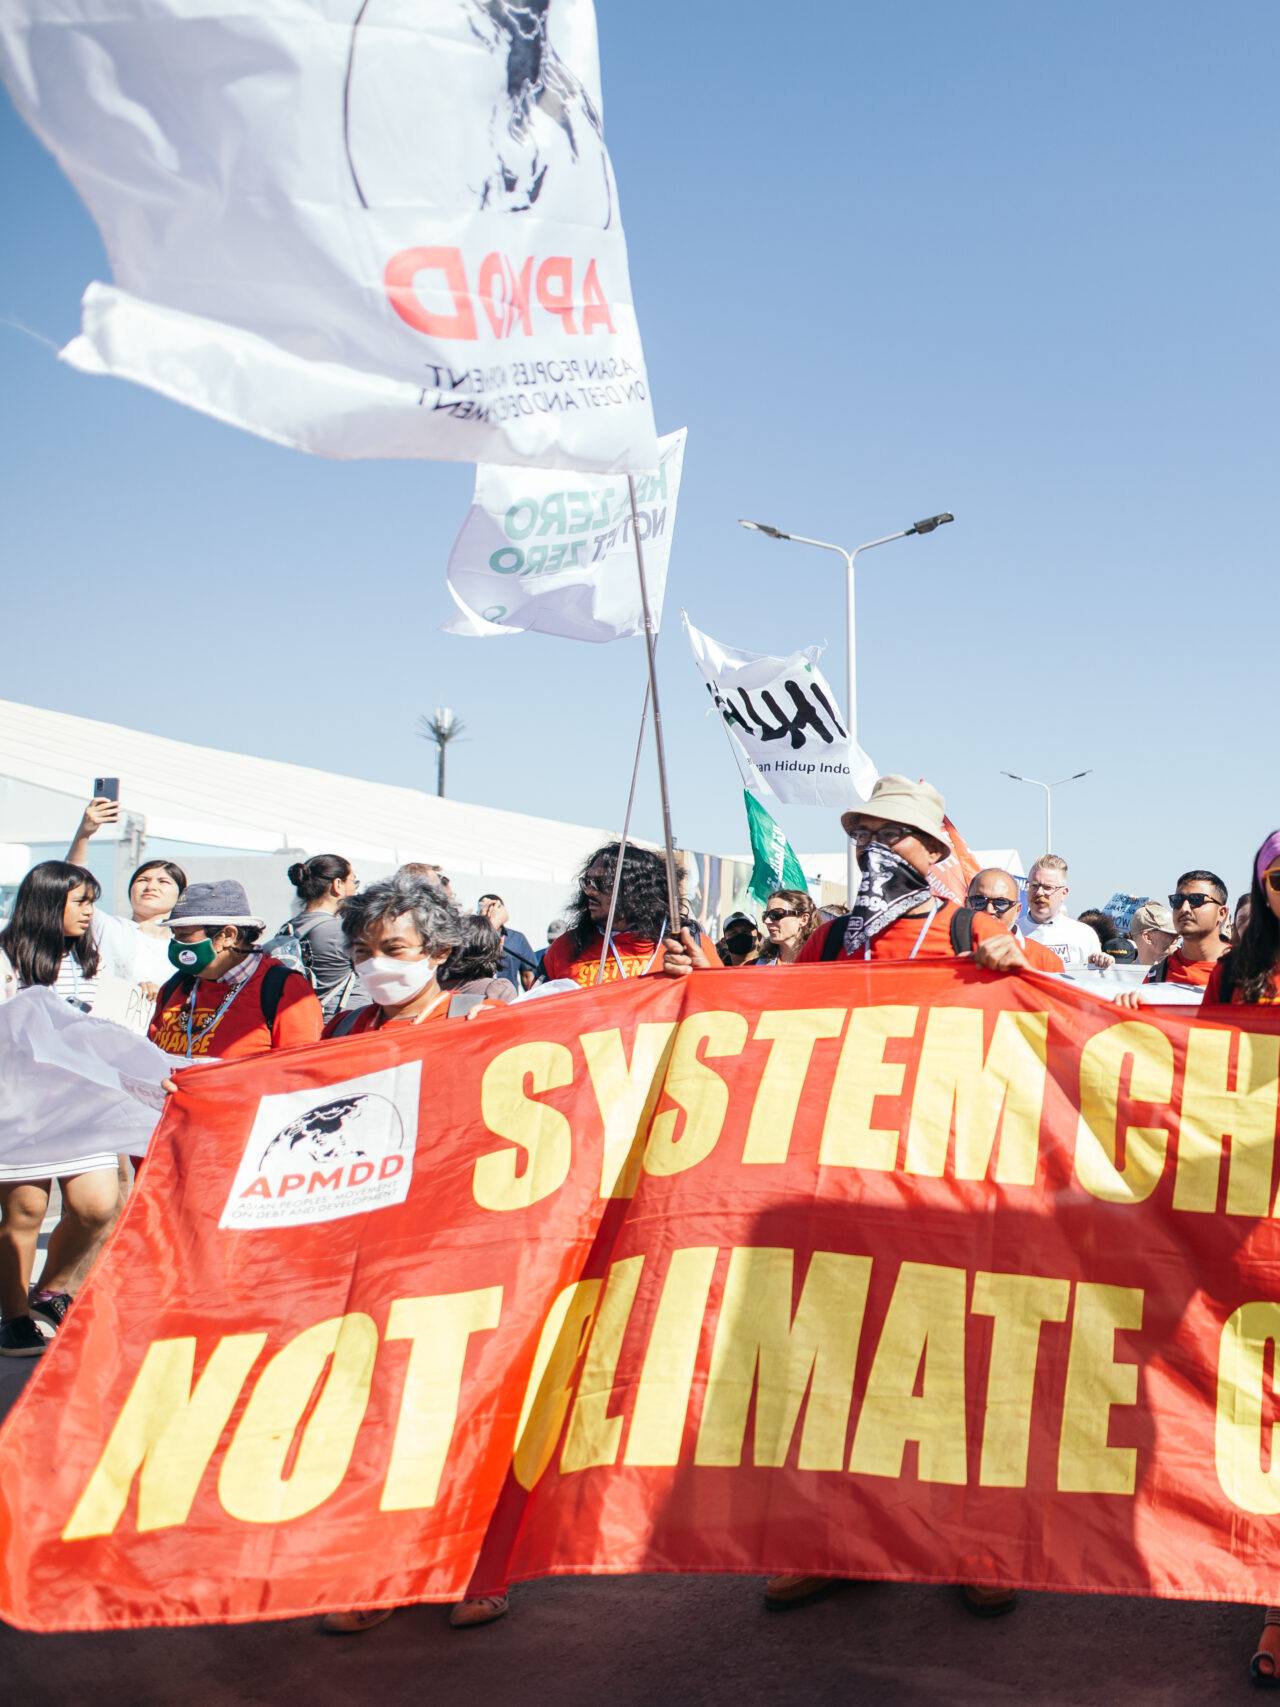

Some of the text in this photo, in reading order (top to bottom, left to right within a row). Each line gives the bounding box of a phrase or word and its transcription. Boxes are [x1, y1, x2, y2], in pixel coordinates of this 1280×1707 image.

[775, 760, 816, 775] Hidup
[820, 763, 851, 775] Indo
[126, 987, 153, 1031] PAY
[473, 1005, 1048, 1211] SYSTEM
[237, 1200, 277, 1210] ASIAN
[334, 1180, 399, 1199] MOVEMENT
[238, 1154, 405, 1199] APMDD
[231, 1188, 399, 1220] ON DEBT AND DEVELOPMENT
[63, 1286, 503, 1541] NOT
[512, 1247, 1145, 1495] CLIMATE
